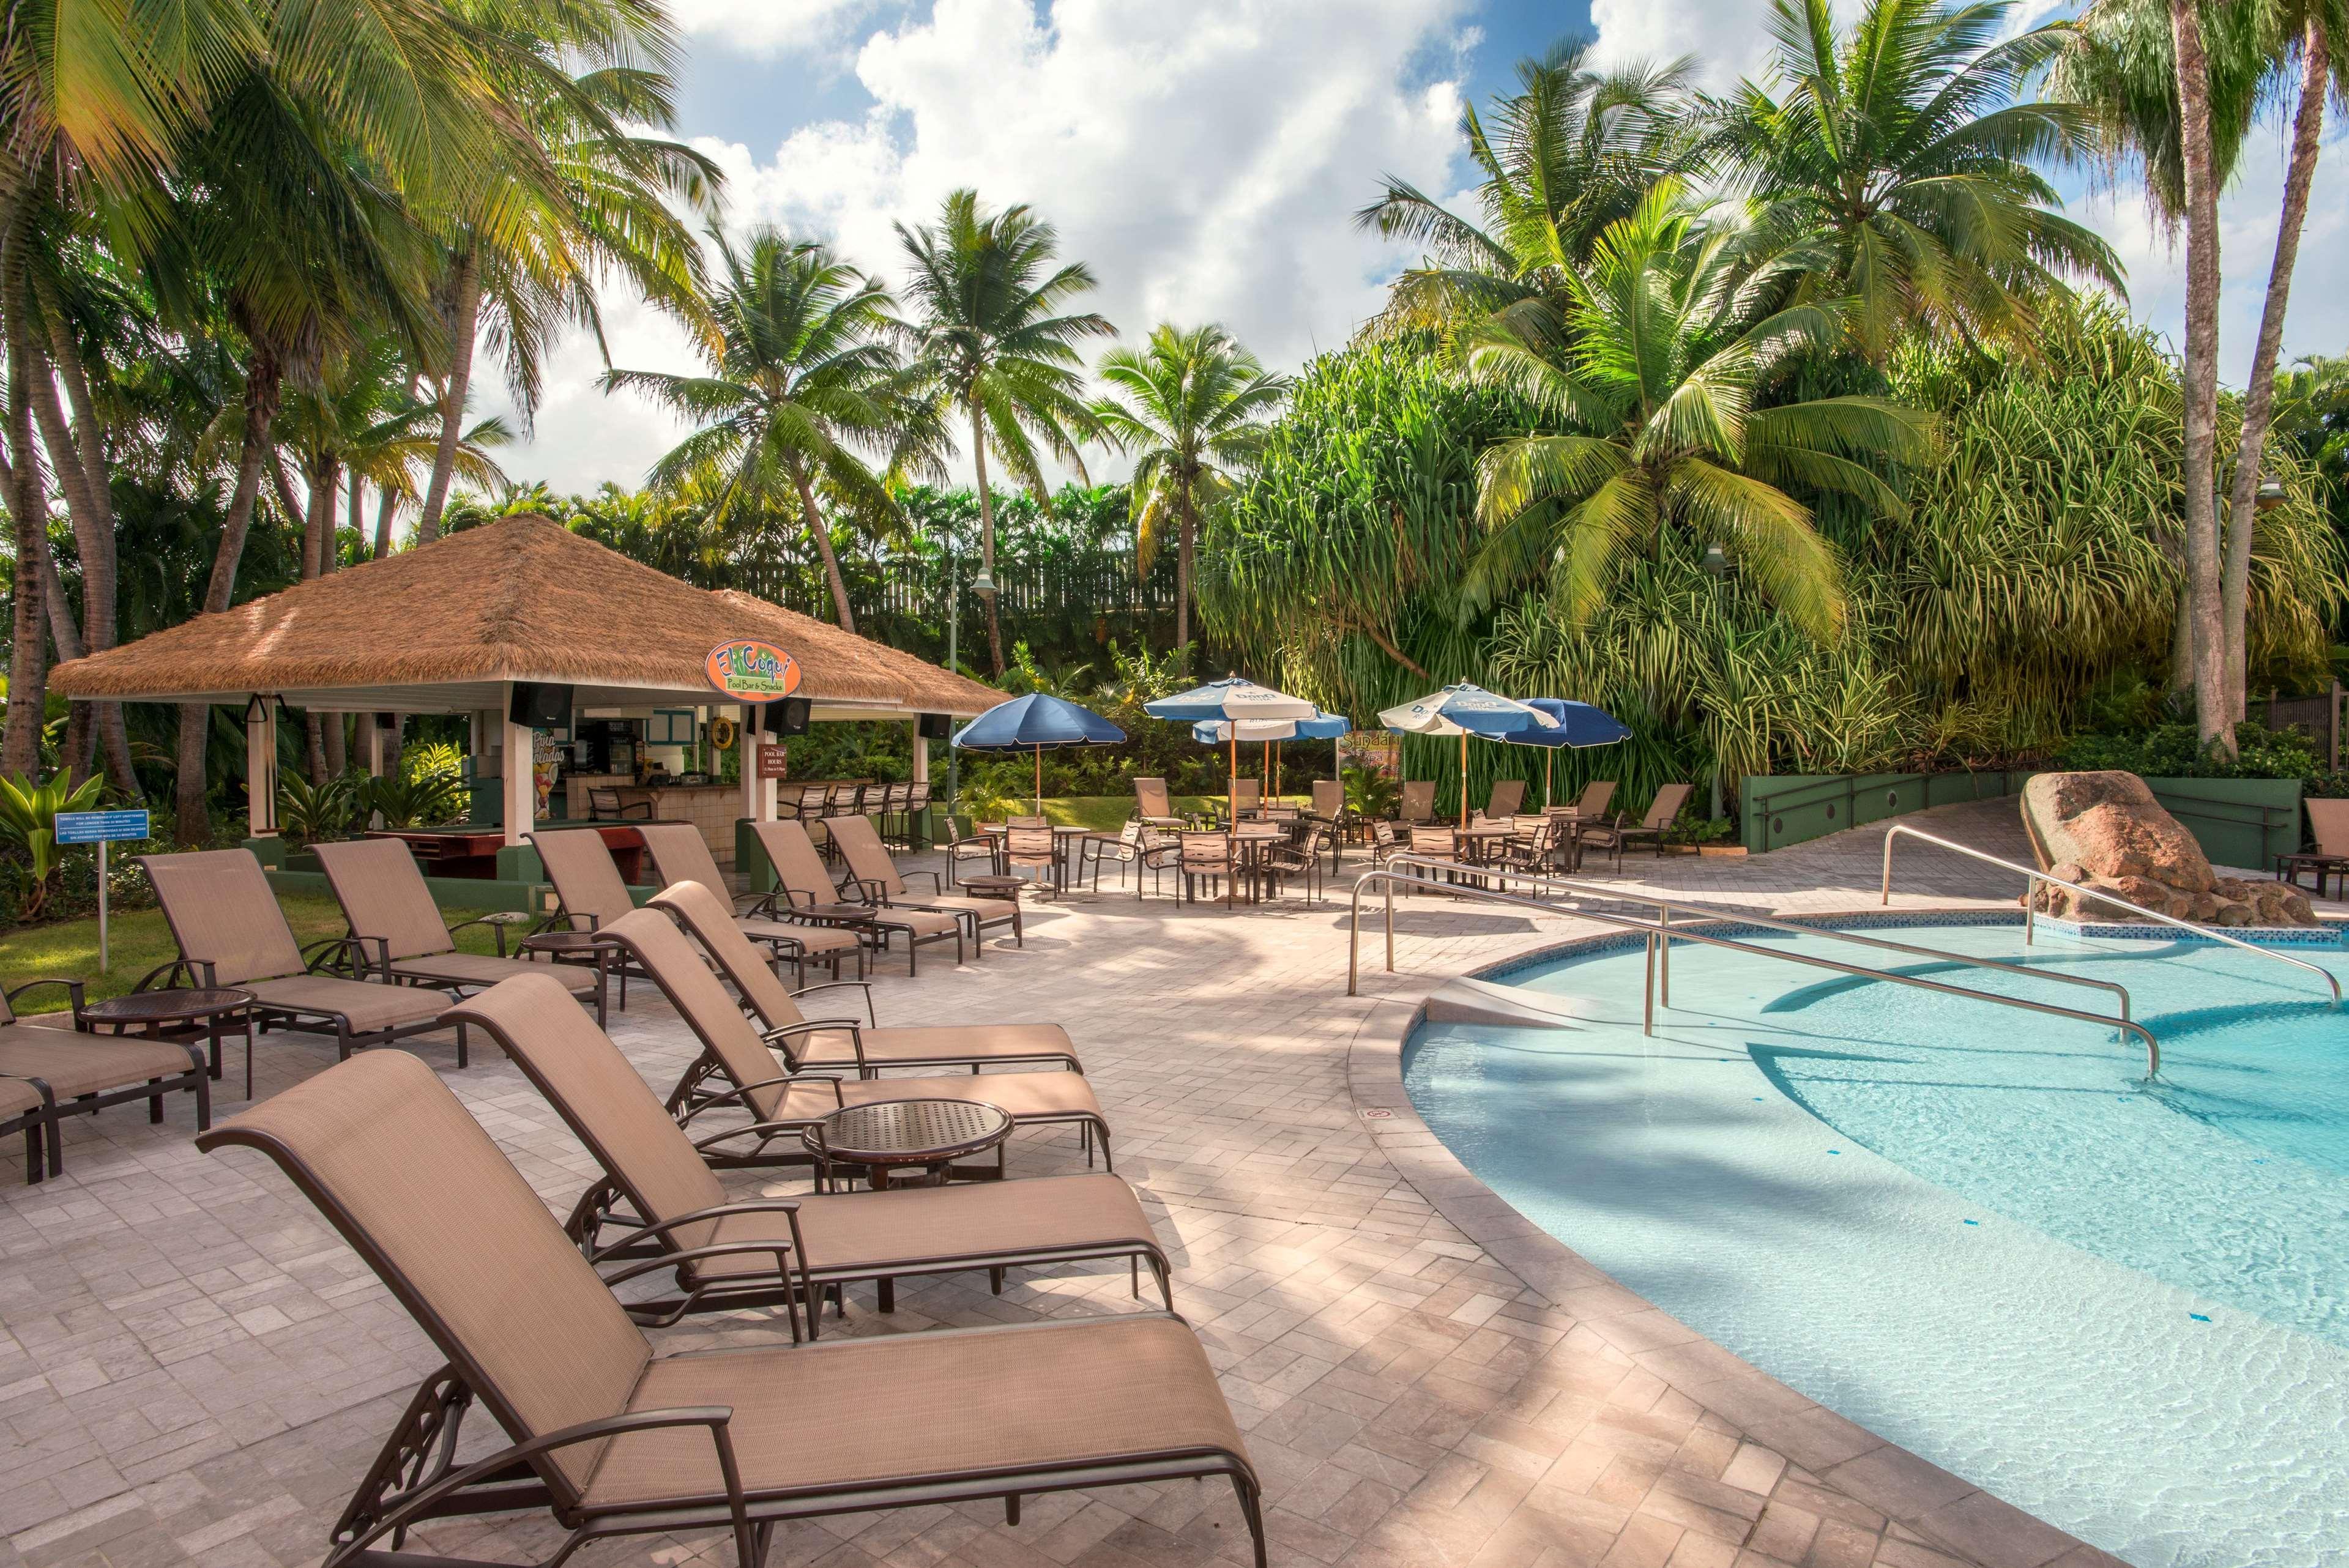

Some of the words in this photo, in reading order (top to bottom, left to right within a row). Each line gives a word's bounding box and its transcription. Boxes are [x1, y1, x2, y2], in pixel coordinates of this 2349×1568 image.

[715, 645, 737, 677] El
[728, 678, 742, 689] Pool
[742, 680, 754, 690] Bar
[760, 680, 783, 691] Snacks
[533, 746, 565, 764] oladas
